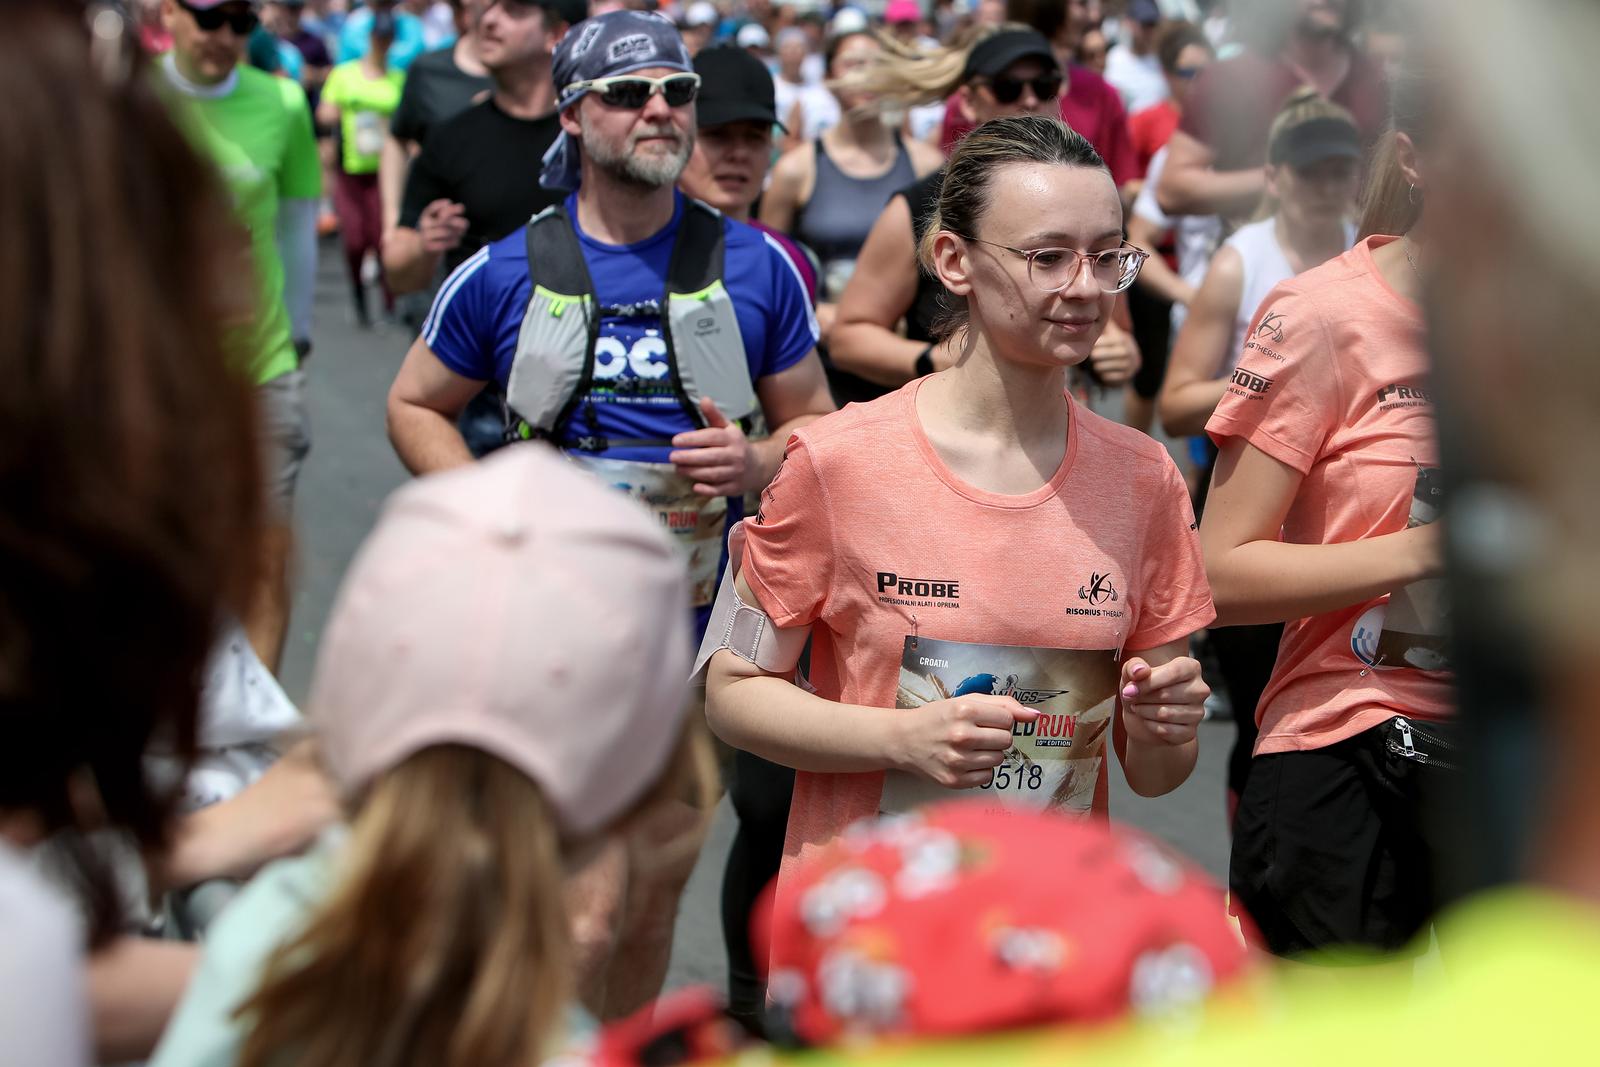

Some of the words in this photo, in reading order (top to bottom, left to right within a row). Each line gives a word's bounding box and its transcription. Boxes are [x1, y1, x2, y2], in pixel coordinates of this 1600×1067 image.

[1256, 343, 1287, 364] THERAPY
[1230, 369, 1274, 393] ROBE
[877, 572, 959, 598] PROBE
[879, 596, 917, 607] PROFESIONALNI
[1066, 607, 1101, 617] RISORIUS
[1102, 609, 1124, 618] THERAPY
[919, 656, 949, 669] CROATIA
[1036, 713, 1077, 738] RUN
